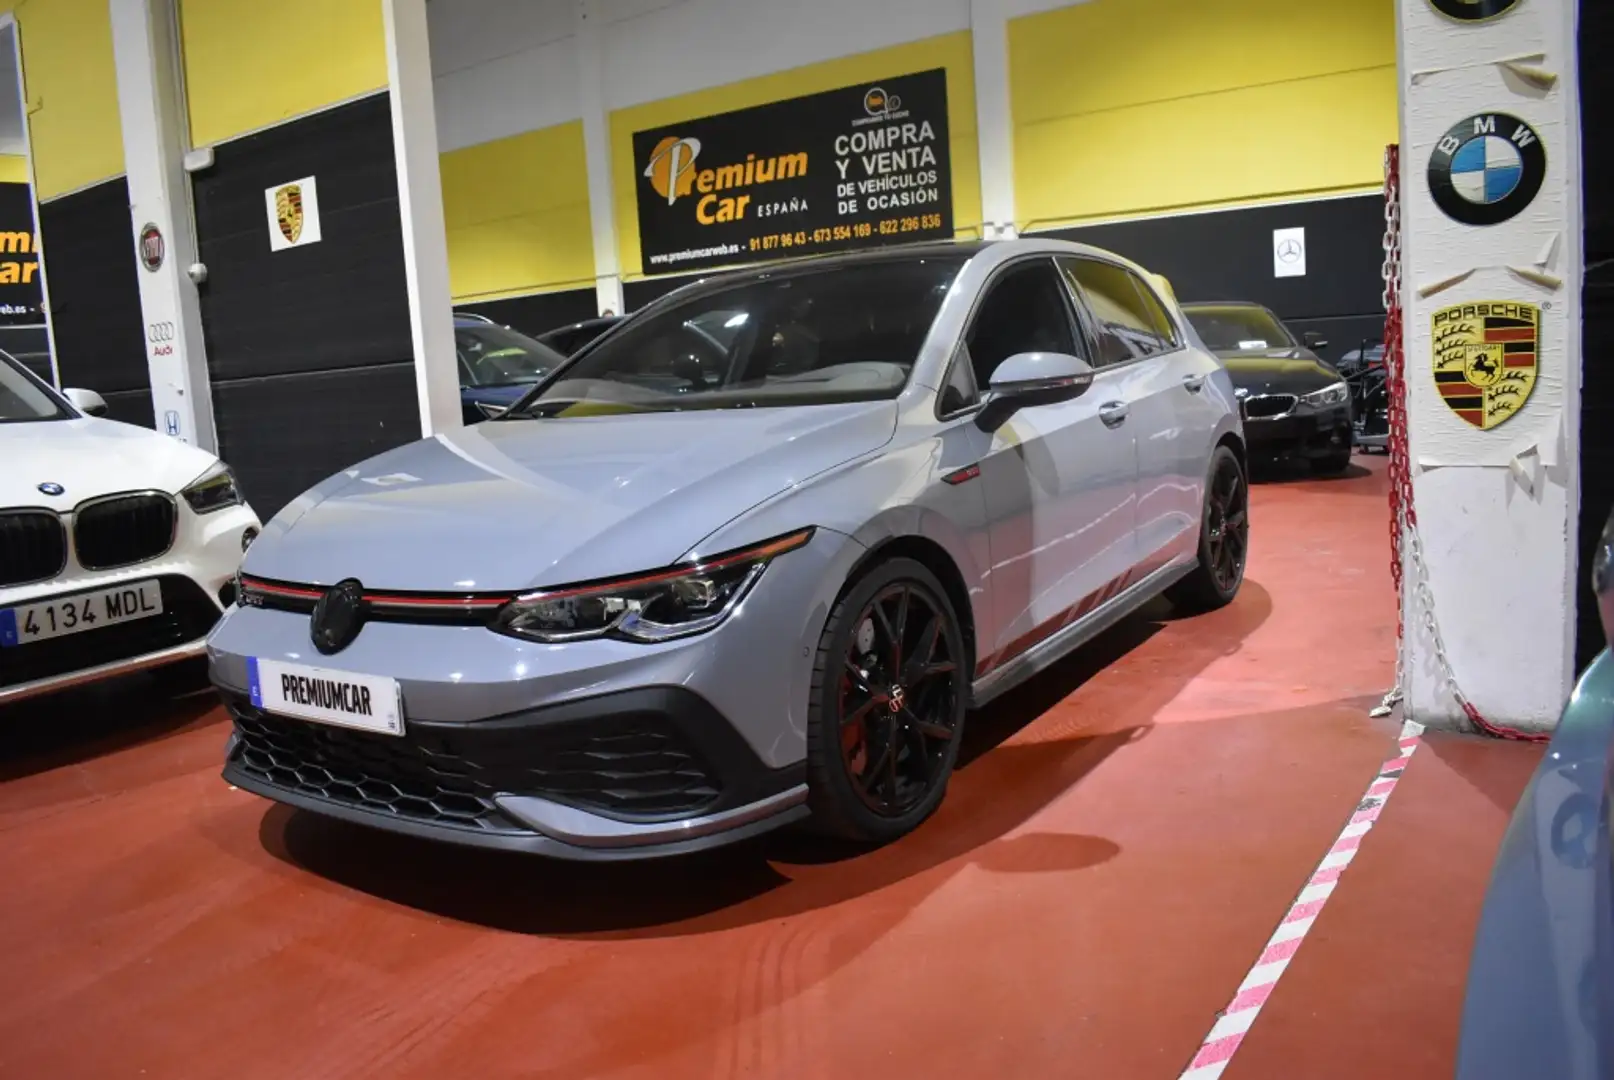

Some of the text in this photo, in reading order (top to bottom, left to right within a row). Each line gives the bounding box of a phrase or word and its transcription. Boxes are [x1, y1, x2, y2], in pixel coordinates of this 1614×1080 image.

[834, 120, 936, 156] COMPRA
[1438, 115, 1536, 156] BMW
[835, 145, 937, 180] Y VENTA
[836, 170, 938, 198] DE VEHÍCULOS
[696, 194, 751, 225] Car
[757, 197, 809, 217] ESPAÑA
[838, 186, 938, 215] DE OCASIÓN
[749, 238, 761, 251] 91
[762, 235, 779, 249] 877
[794, 231, 806, 245] 43
[813, 228, 832, 243] 673
[879, 219, 898, 234] 622
[0, 261, 39, 283] ar
[1434, 303, 1533, 326] PORSCHE
[23, 588, 156, 636] 4134 MDL
[281, 673, 373, 716] PREMIUMCAR
